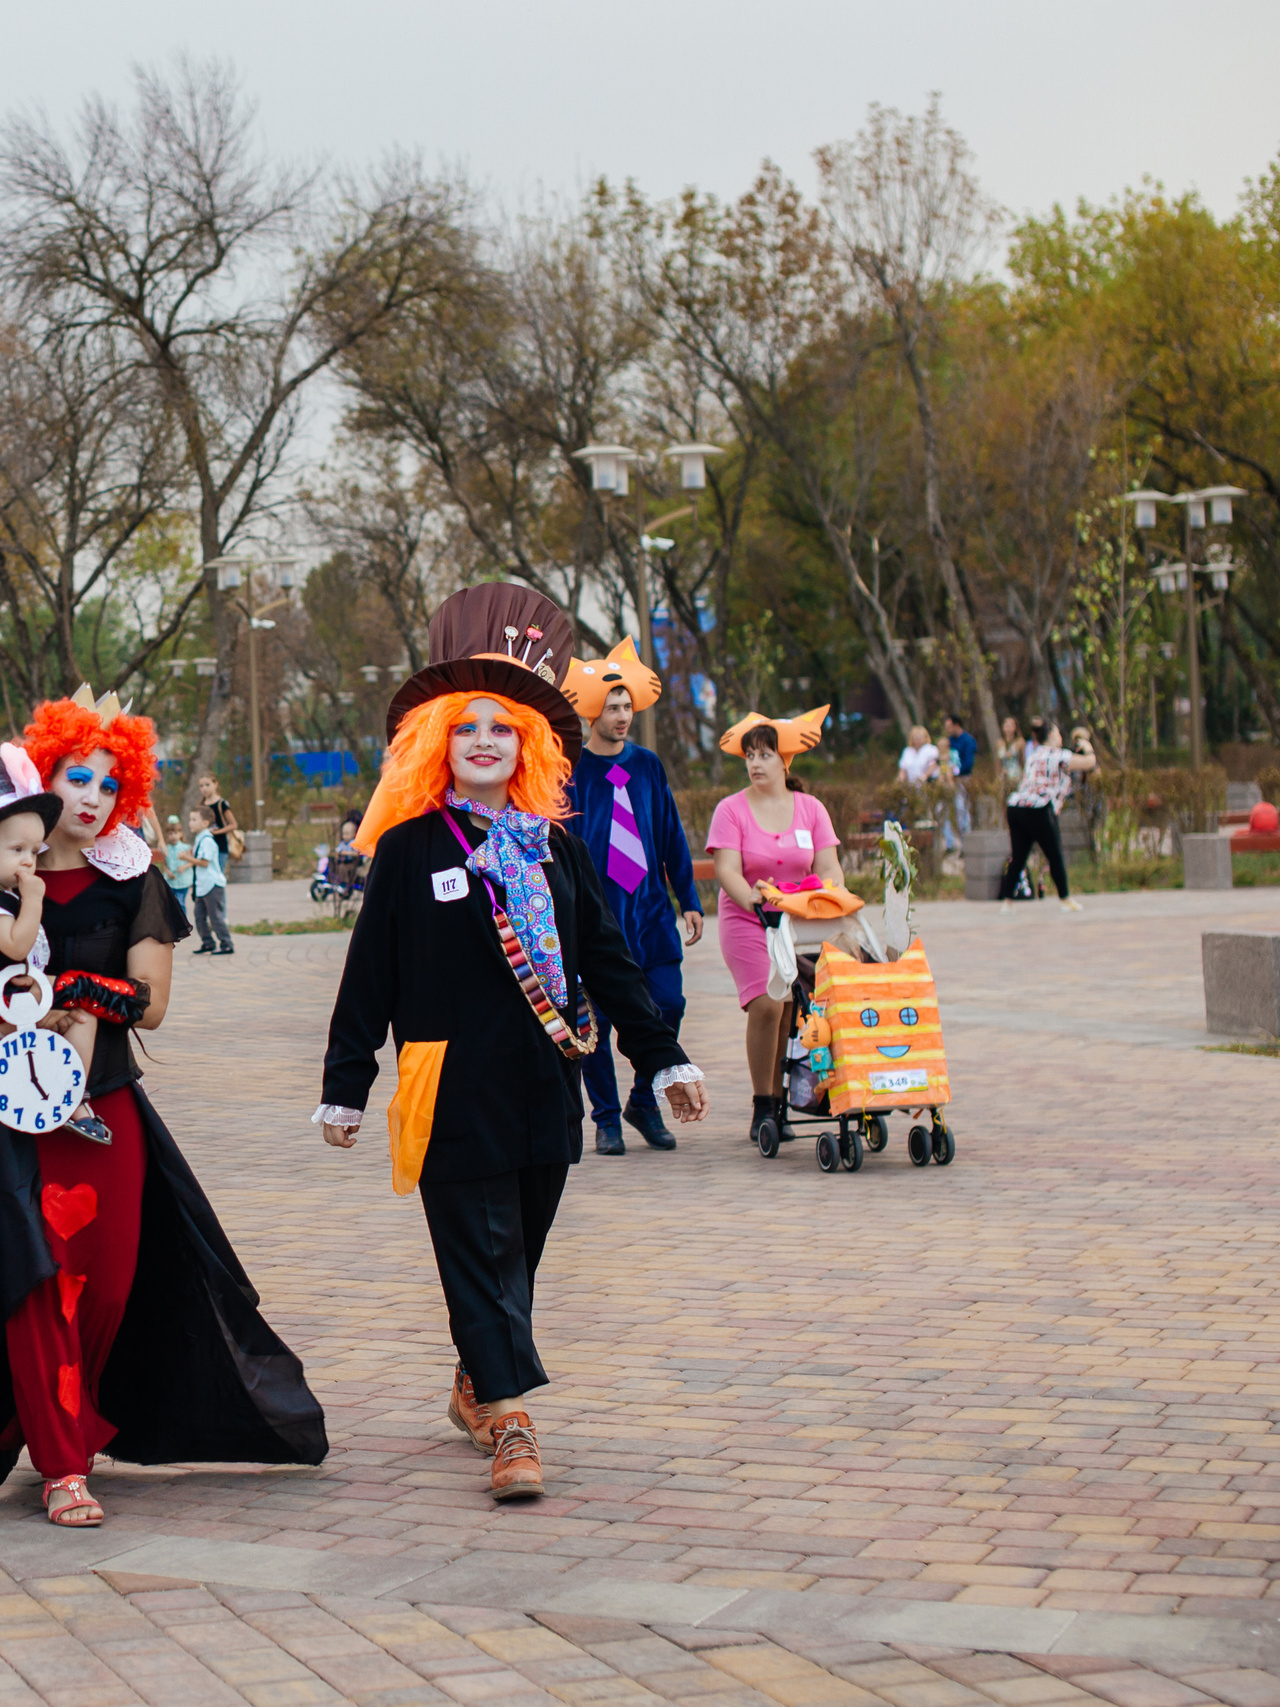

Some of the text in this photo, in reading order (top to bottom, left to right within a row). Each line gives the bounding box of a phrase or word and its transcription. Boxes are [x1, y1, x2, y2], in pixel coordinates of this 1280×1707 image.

[442, 878, 456, 892] 117
[2, 1038, 18, 1058] 11
[19, 1031, 36, 1049] 12
[47, 1034, 55, 1051] 1
[62, 1048, 71, 1064] 2
[72, 1070, 81, 1086] 3
[62, 1090, 73, 1106] 4
[13, 1107, 24, 1124] 7
[35, 1112, 45, 1129] 6
[53, 1105, 62, 1122] 5
